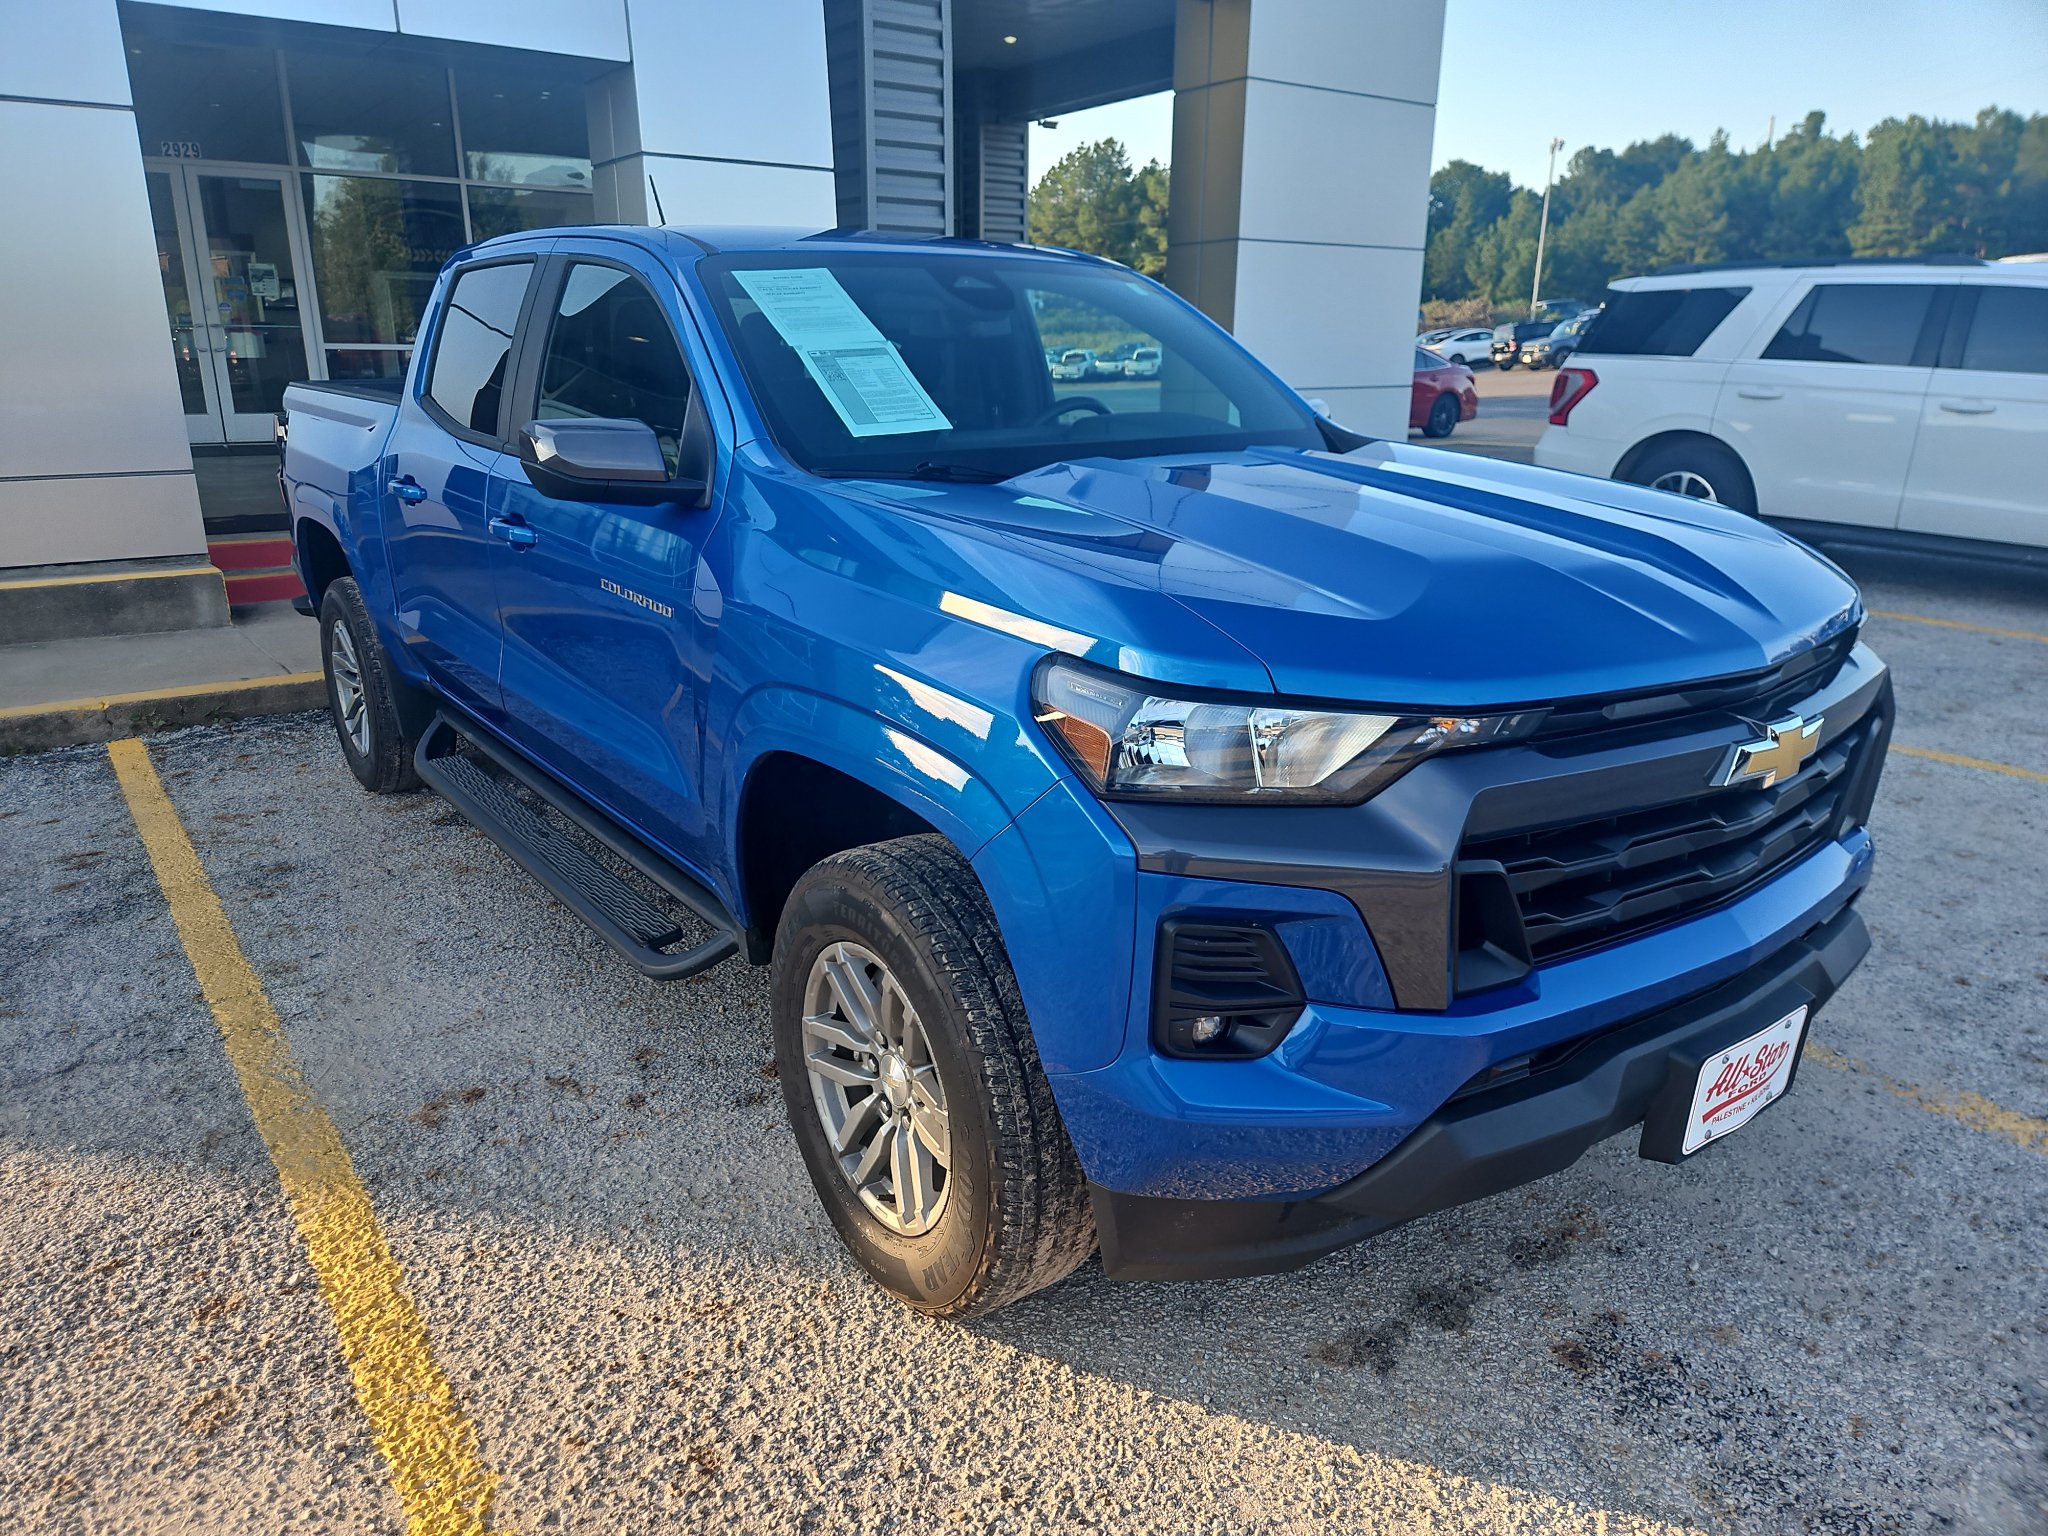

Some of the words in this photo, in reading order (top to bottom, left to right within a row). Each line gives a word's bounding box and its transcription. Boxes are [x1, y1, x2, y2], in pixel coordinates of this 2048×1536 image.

[162, 141, 200, 158] 2929
[600, 578, 672, 618] COLORADO
[1705, 1053, 1750, 1102] All
[1727, 1071, 1767, 1099] FORD
[1711, 1101, 1748, 1125] PALESTINE
